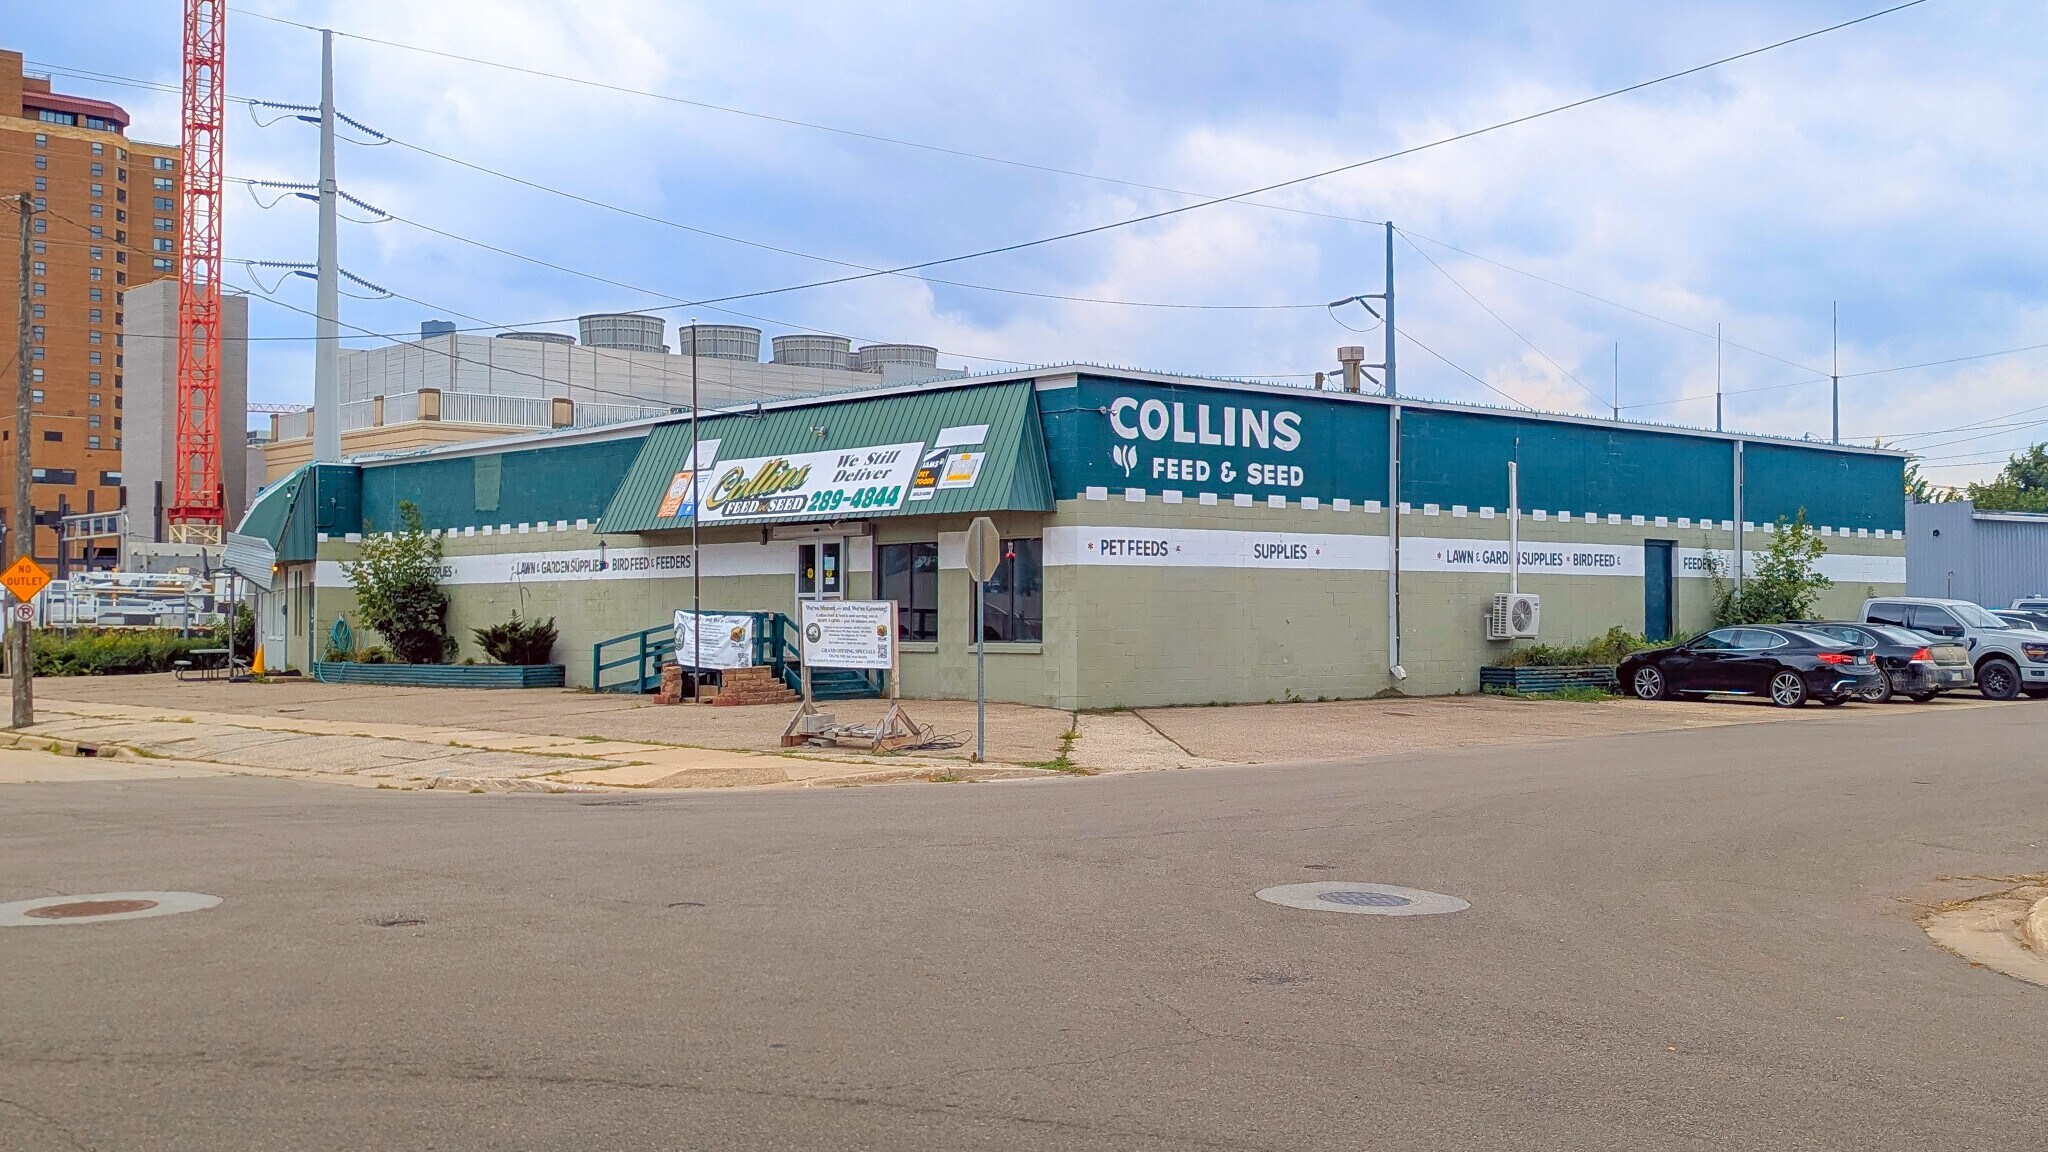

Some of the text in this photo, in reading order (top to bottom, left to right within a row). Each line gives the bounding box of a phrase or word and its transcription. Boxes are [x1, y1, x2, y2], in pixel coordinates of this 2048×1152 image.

[1110, 397, 1302, 451] COLLINS
[837, 450, 901, 468] We Still
[832, 468, 892, 482] Deliver
[1152, 457, 1304, 487] FEED & SEED
[706, 458, 812, 511] Collins
[725, 500, 760, 514] FEED
[768, 497, 804, 512] SEED
[807, 485, 901, 511] 289-4844
[1100, 539, 1168, 557] PET FEEDS
[1253, 543, 1307, 560] SUPPLIES
[516, 562, 536, 575] LAWN
[541, 561, 570, 574] GARDEN
[570, 560, 601, 573] SUPPLIE
[612, 558, 630, 571] BIRD
[630, 557, 649, 570] FEED
[656, 555, 691, 569] FEEDERS
[1446, 549, 1474, 564] LAWN
[1521, 552, 1563, 566] SUPPLIES
[1573, 553, 1593, 567] BIRD
[1594, 554, 1615, 567] FEED
[18, 565, 32, 573] NO
[6, 577, 42, 586] OUTLET
